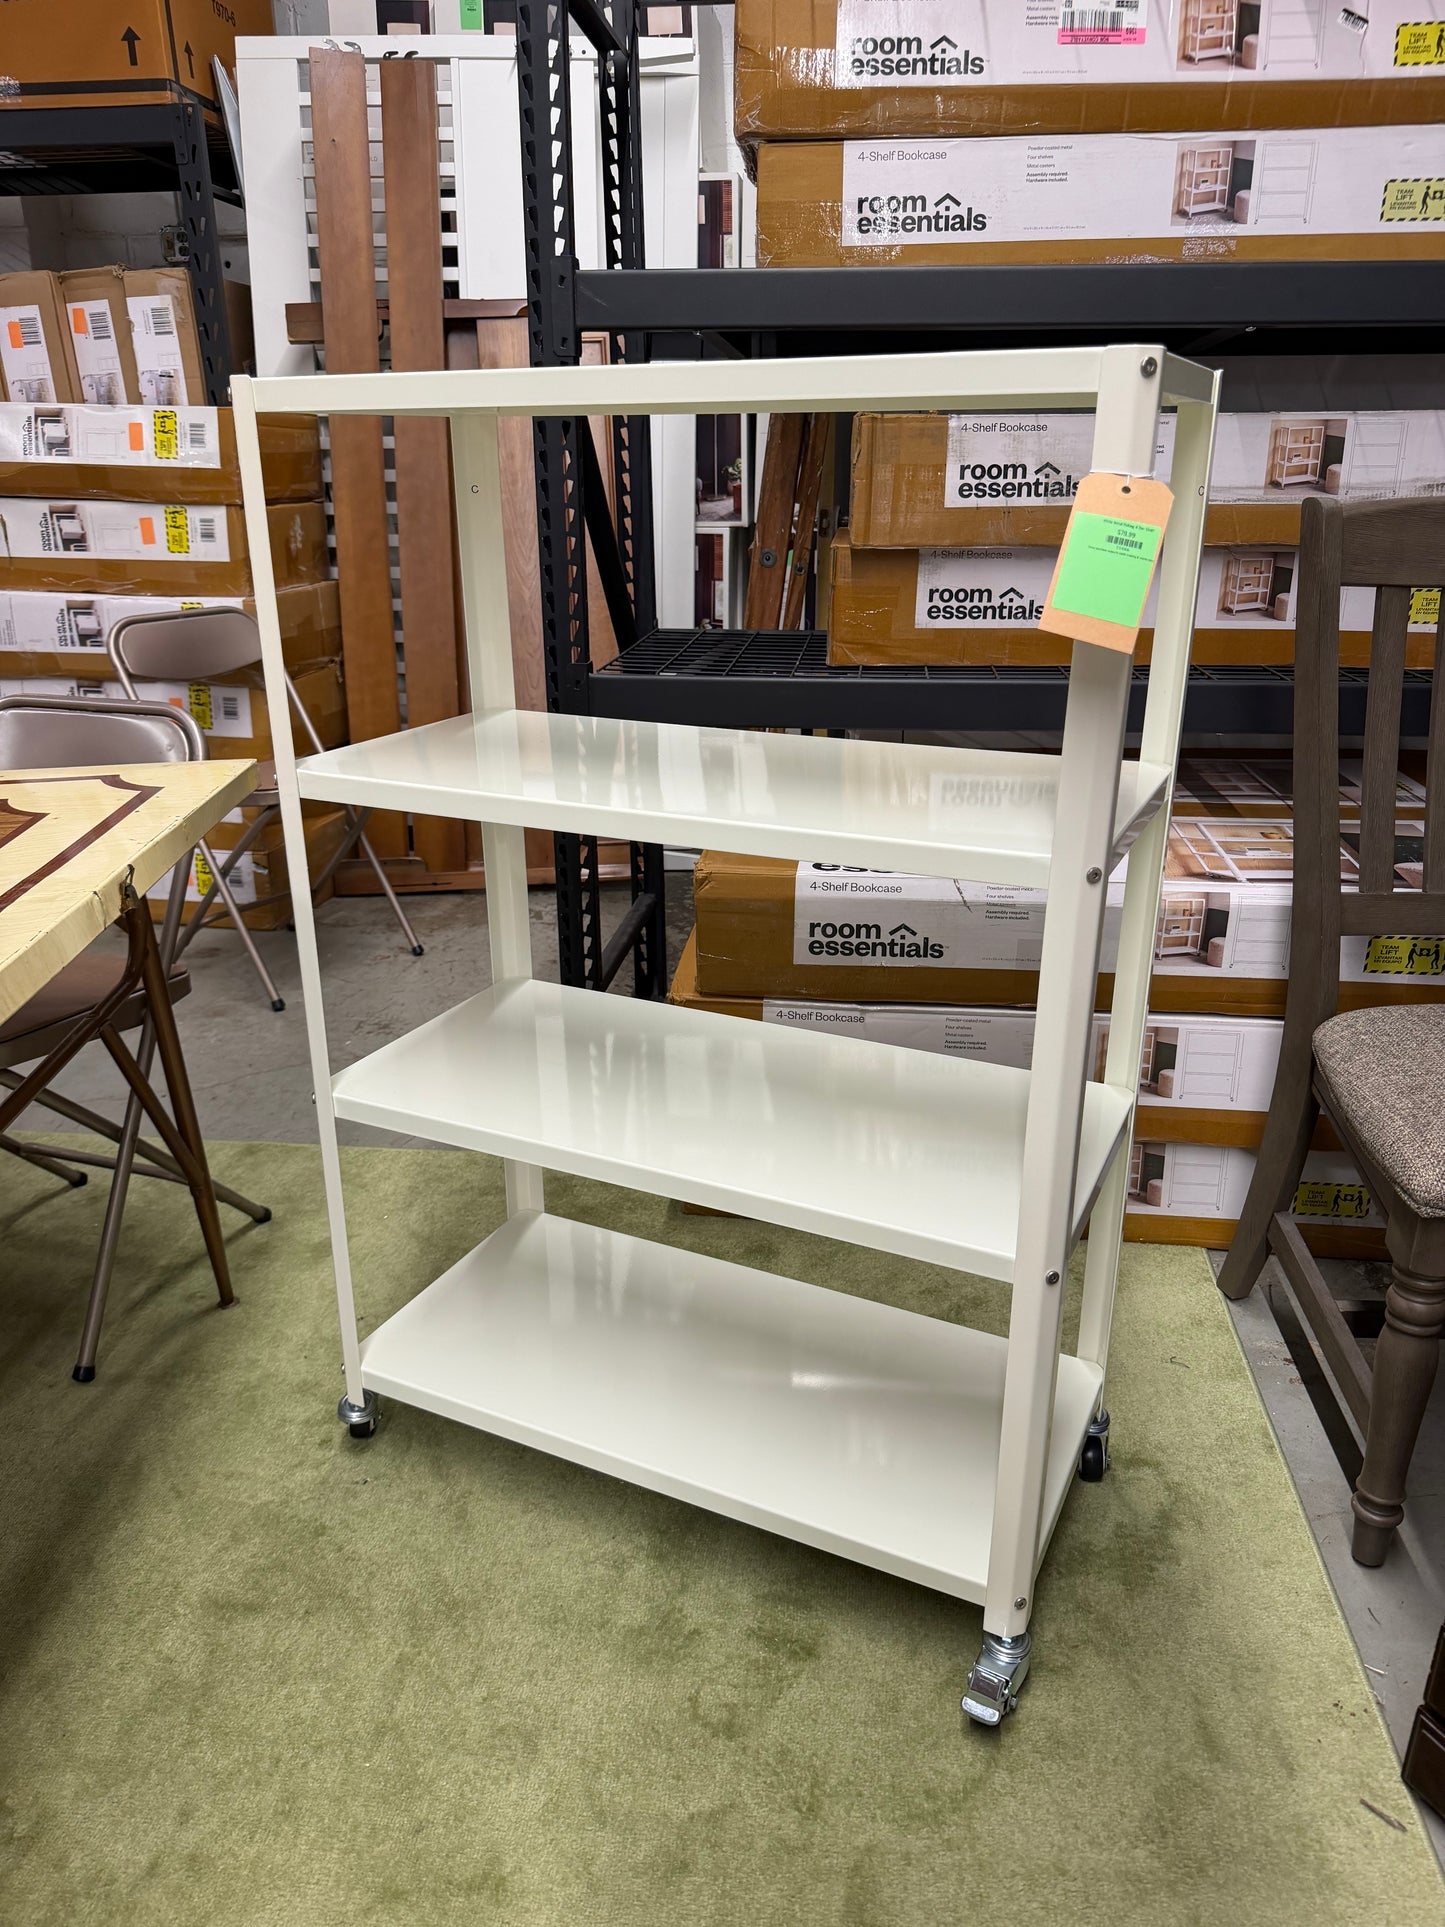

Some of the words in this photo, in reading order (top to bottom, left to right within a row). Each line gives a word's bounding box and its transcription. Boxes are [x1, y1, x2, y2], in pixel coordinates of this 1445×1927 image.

[851, 36, 922, 55] room
[851, 49, 984, 76] essentials
[858, 150, 895, 162] 4-Shelf
[898, 150, 947, 161] Bookcase
[857, 195, 926, 214] room
[857, 206, 987, 234] essentials
[961, 423, 997, 433] 4-Shelf
[1000, 423, 1048, 432] Bookcase
[960, 463, 1026, 480] room
[471, 485, 479, 493] C
[1117, 529, 1136, 538] $79.99
[930, 550, 965, 559] 4-Shelf
[967, 550, 1013, 559] Bookcase
[929, 588, 992, 603] room
[810, 882, 849, 892] 4-Shelf
[851, 882, 902, 893] Bookcase
[809, 922, 881, 939] room
[808, 935, 944, 958] essentials
[776, 1010, 814, 1020] 4-Shelf
[816, 1012, 865, 1023] Bookcase
